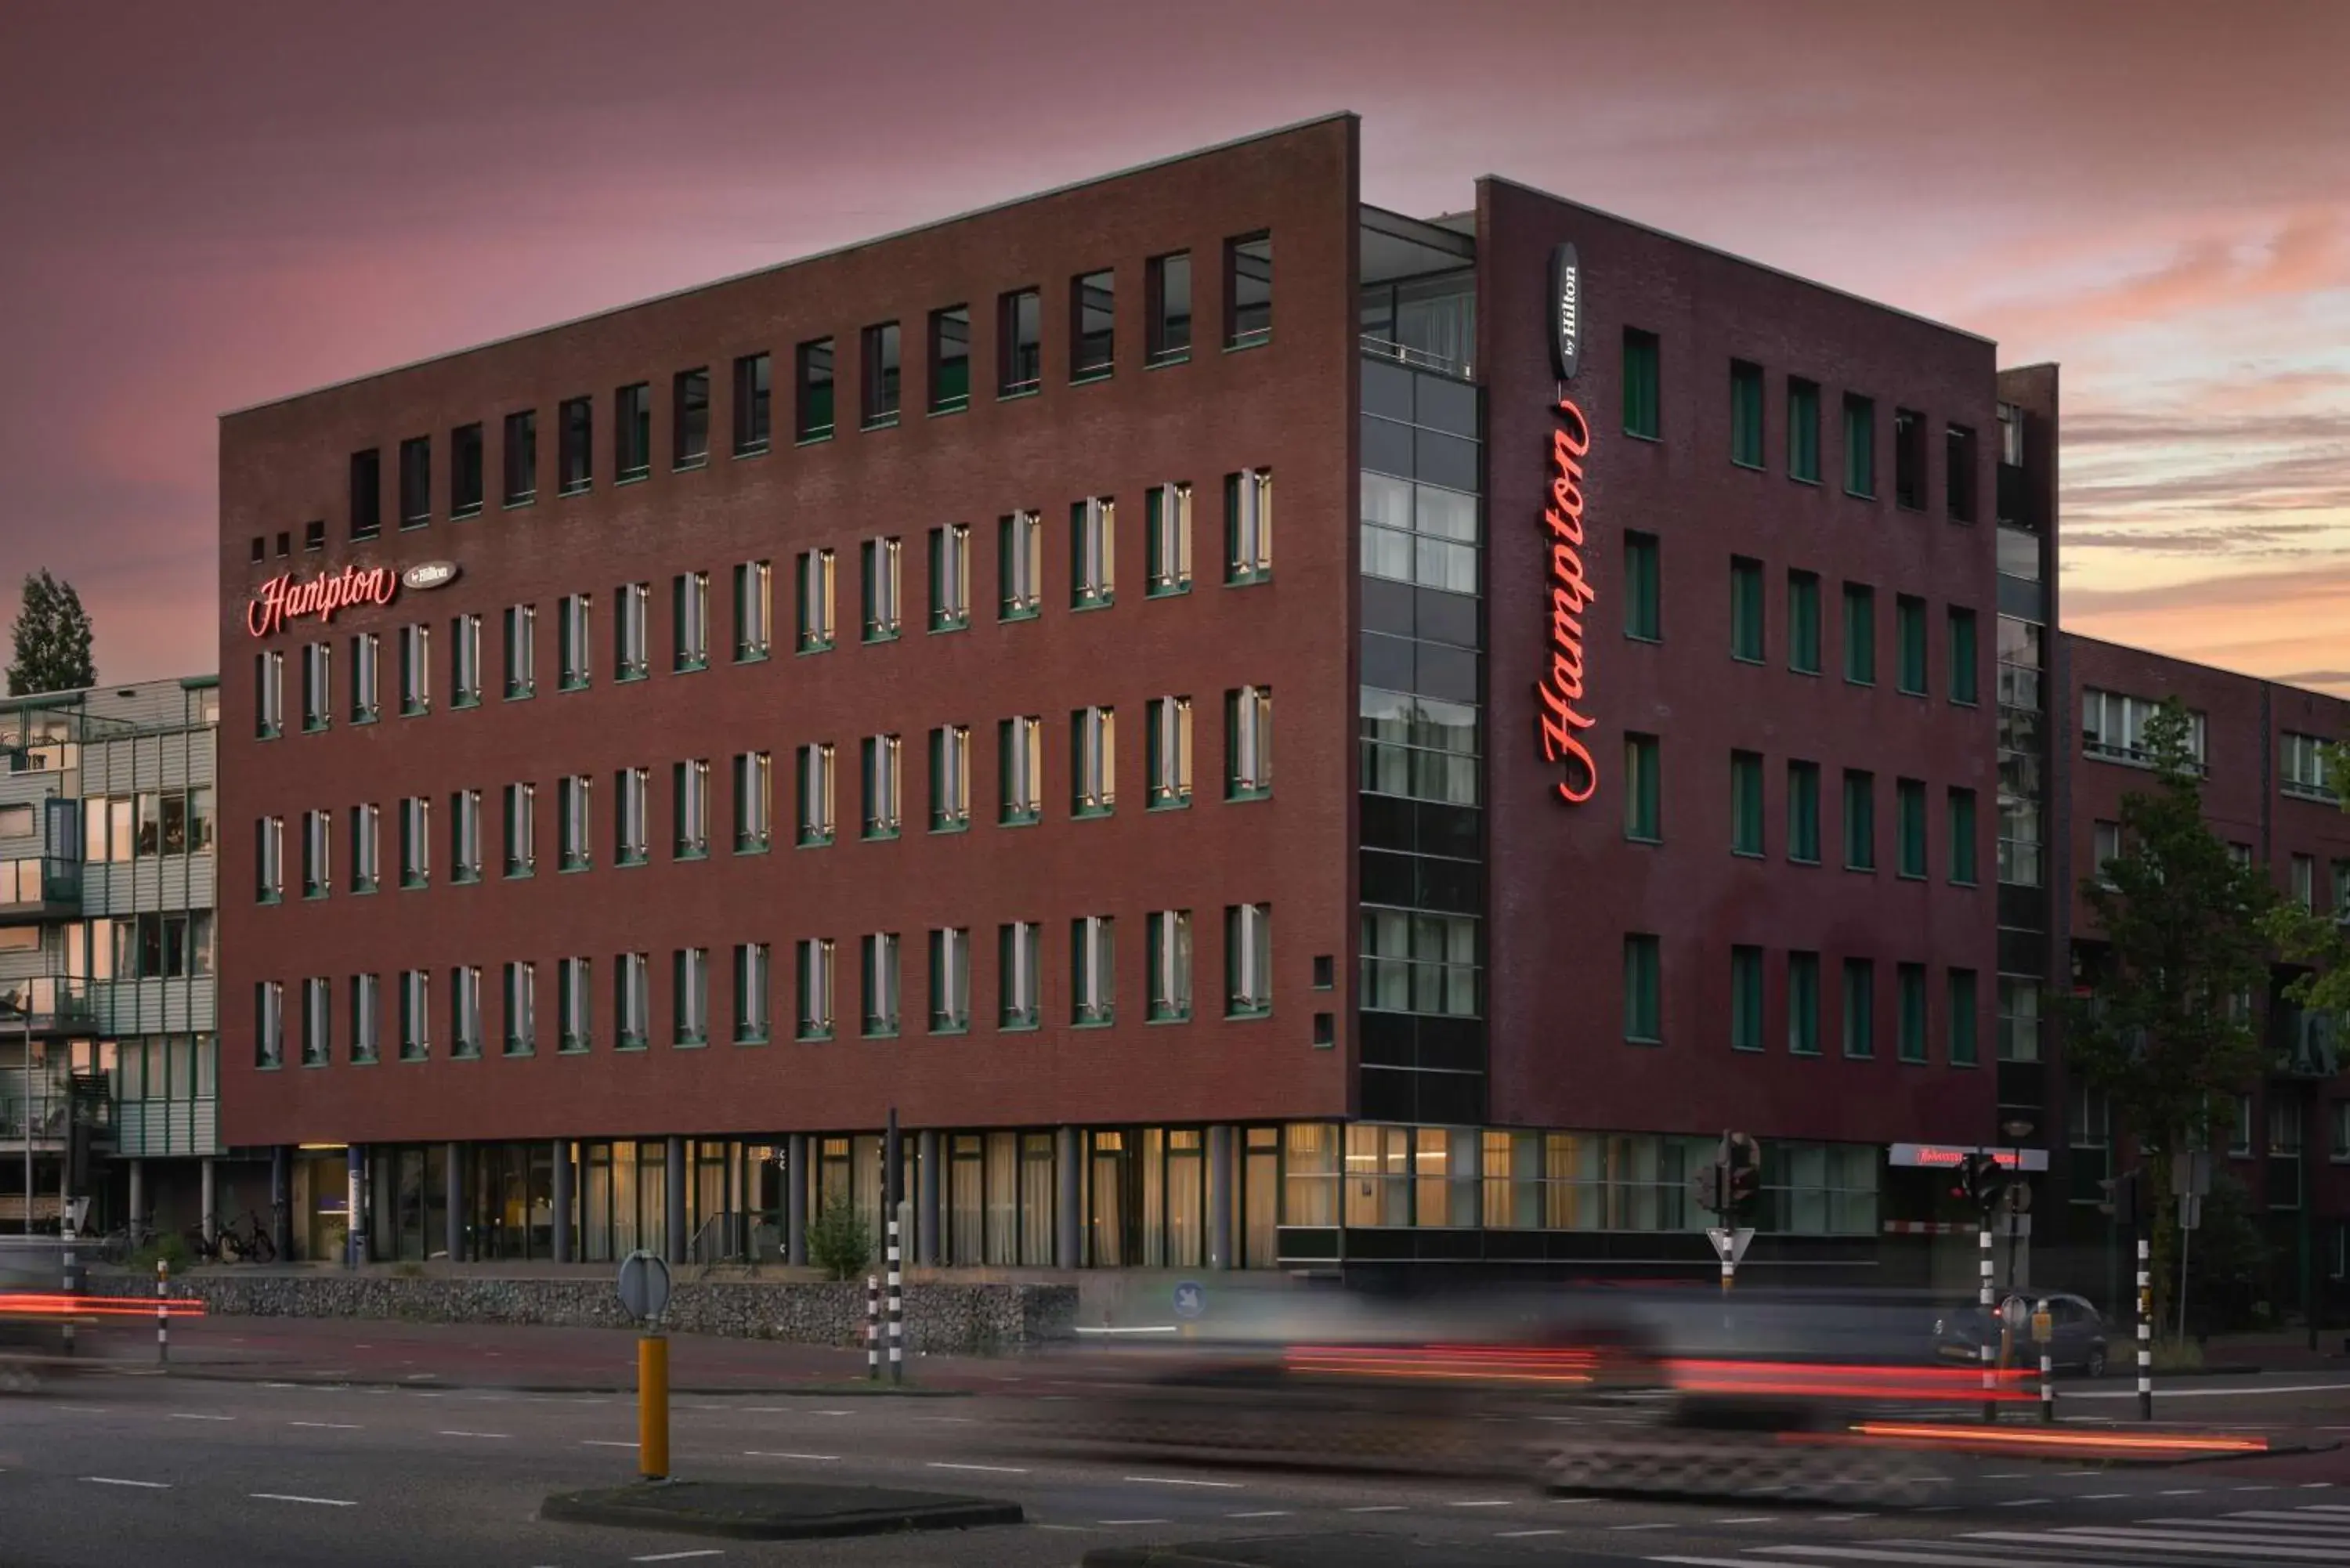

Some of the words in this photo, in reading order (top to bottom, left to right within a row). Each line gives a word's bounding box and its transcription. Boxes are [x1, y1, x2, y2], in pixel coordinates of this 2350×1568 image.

[1562, 267, 1576, 338] Hilton
[1564, 339, 1576, 356] by
[248, 565, 395, 636] Hampton
[419, 566, 447, 581] Hilton
[1539, 400, 1596, 802] Hampton
